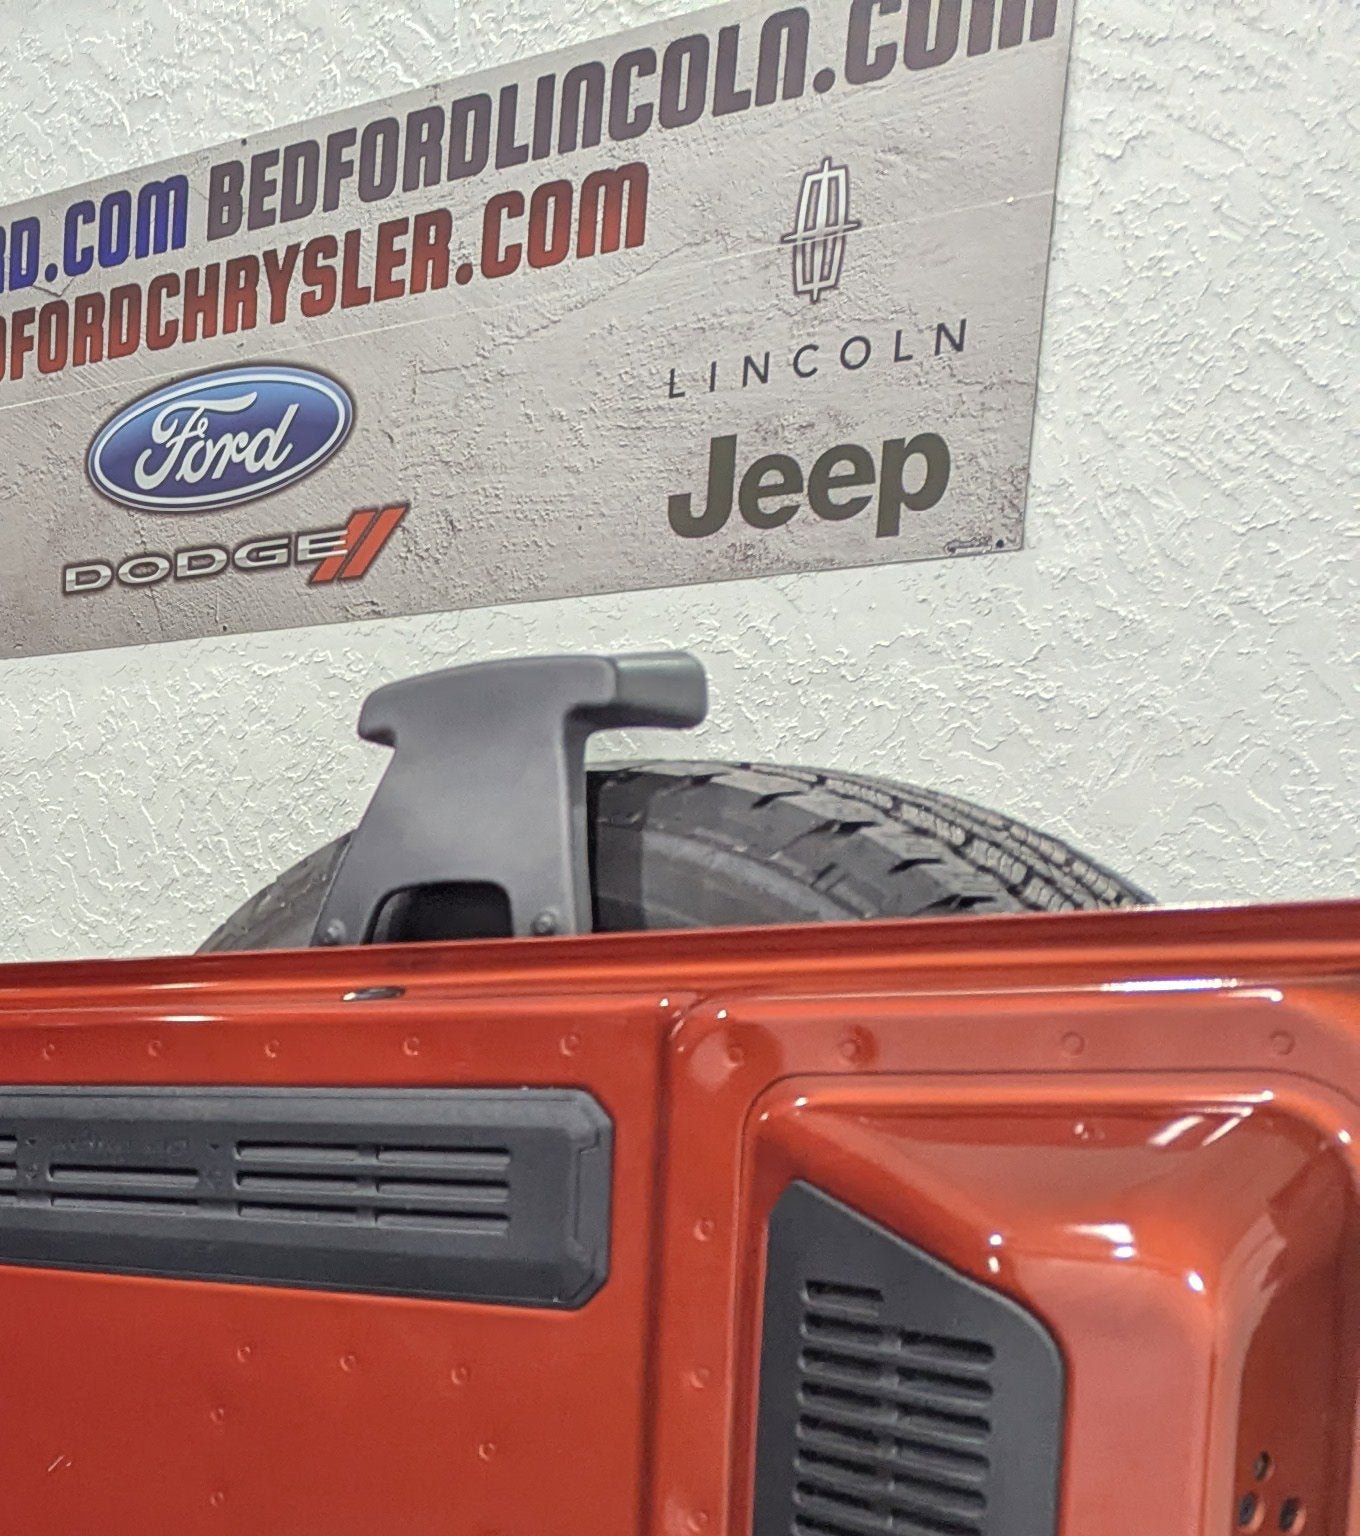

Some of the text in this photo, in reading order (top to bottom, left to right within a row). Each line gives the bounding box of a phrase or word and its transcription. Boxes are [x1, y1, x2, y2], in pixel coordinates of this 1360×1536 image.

[668, 319, 967, 398] LINCOLN
[133, 391, 299, 491] Ford
[668, 432, 951, 538] Jeep
[63, 528, 348, 593] DODGE
